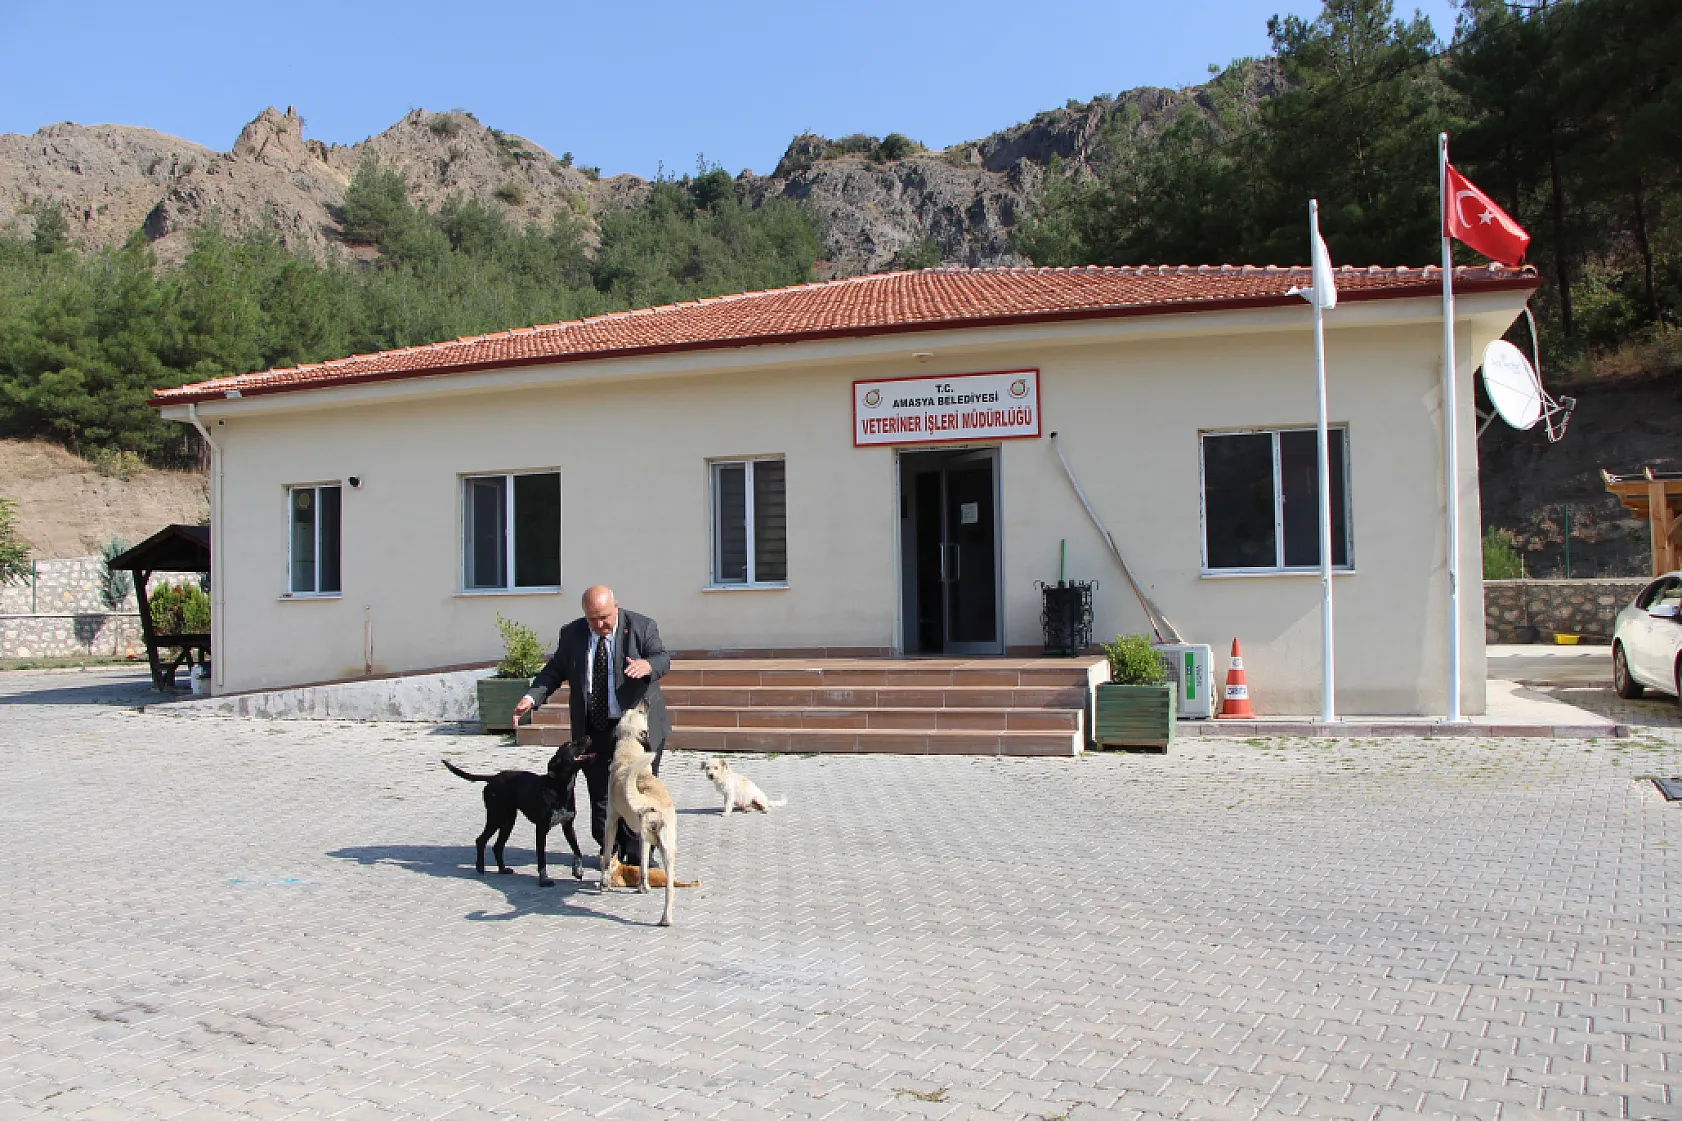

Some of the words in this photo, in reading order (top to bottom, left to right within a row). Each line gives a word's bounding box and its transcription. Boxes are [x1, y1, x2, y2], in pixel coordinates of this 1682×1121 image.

[935, 383, 954, 393] T.C.
[892, 396, 935, 408] AMASYA
[938, 390, 999, 406] BELEDİYESİ
[861, 412, 922, 435] VETERİNER
[924, 410, 959, 435] İŞLERİ
[962, 405, 1032, 429] MÜDÜRLÜĞÜ
